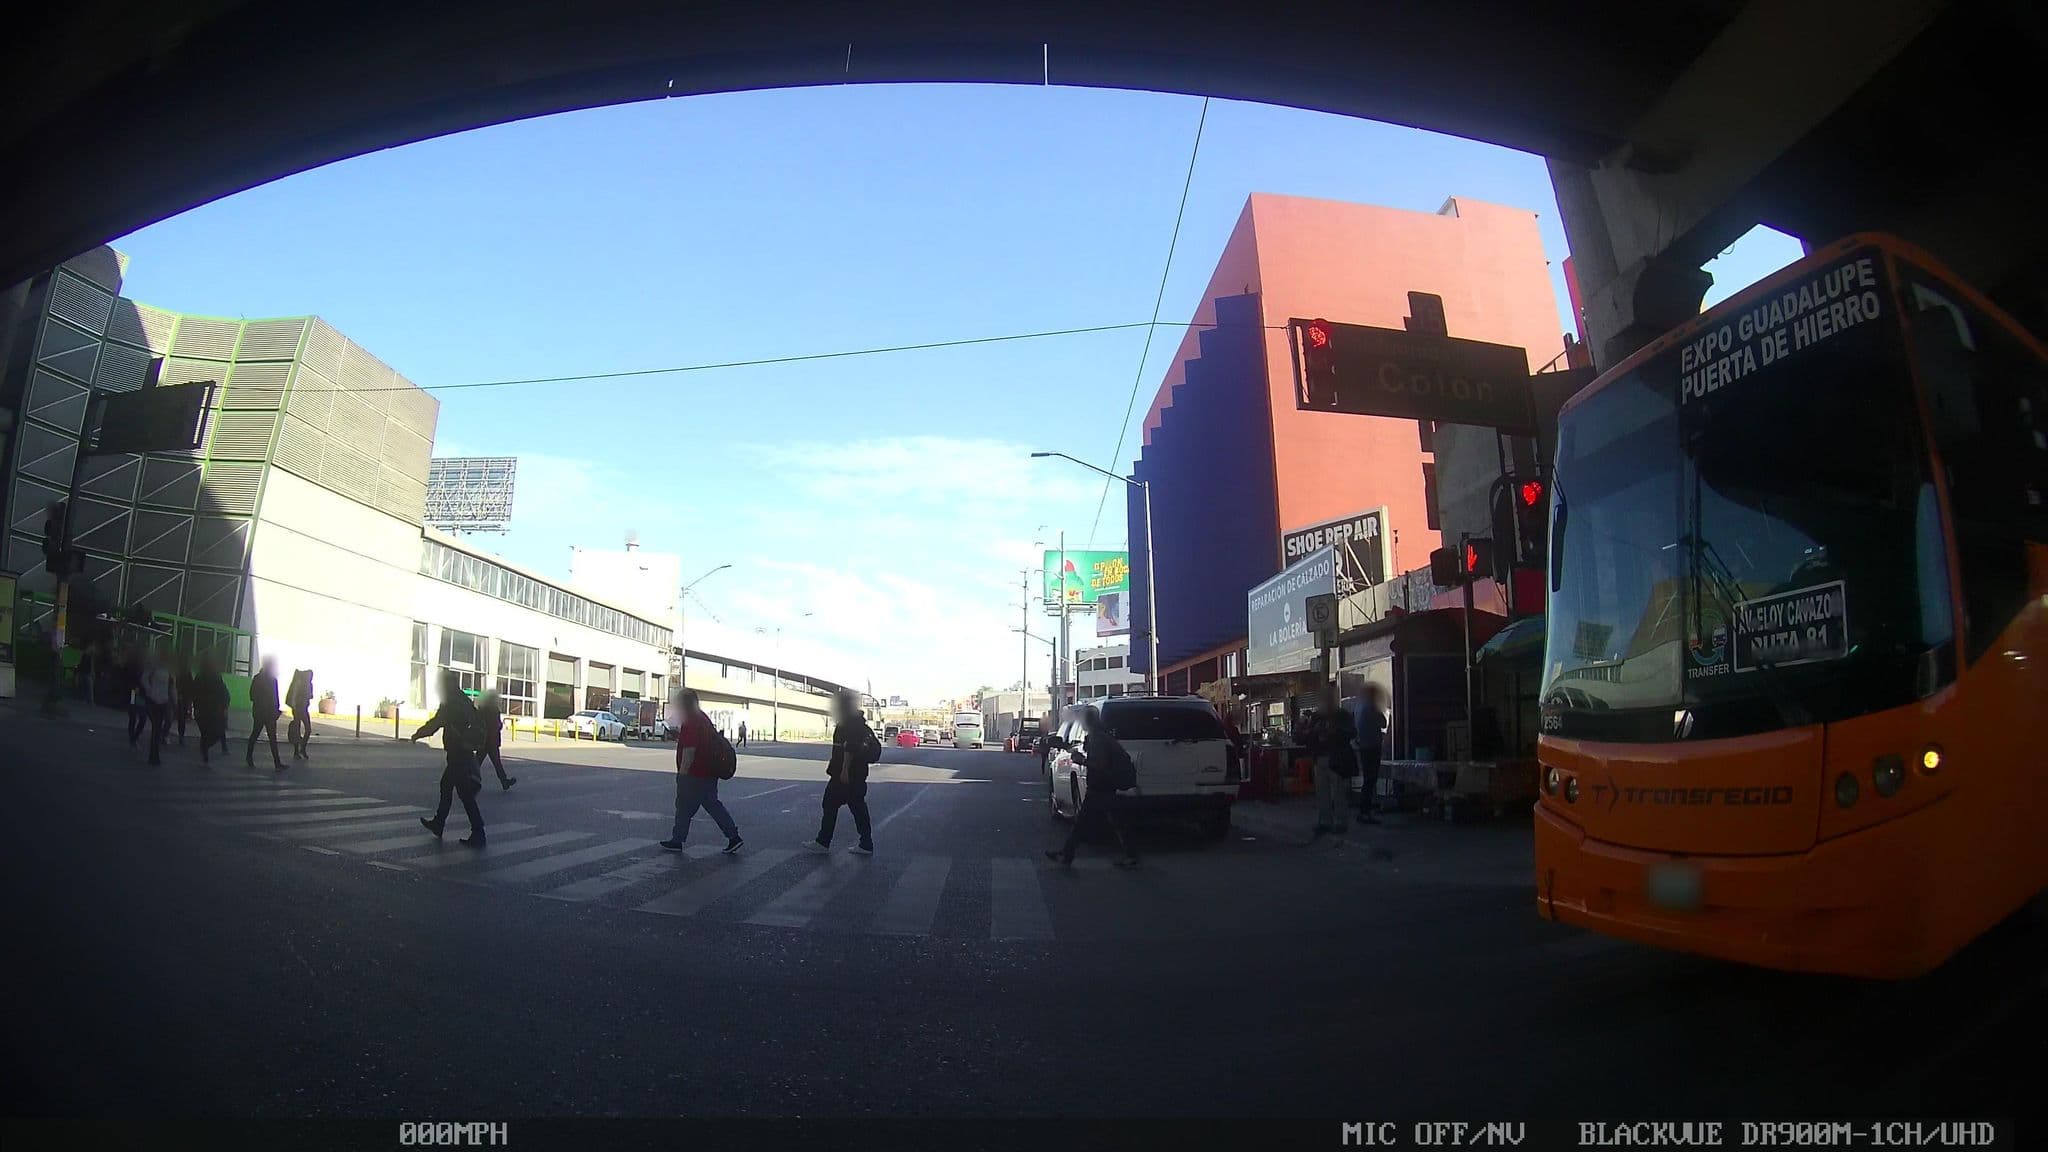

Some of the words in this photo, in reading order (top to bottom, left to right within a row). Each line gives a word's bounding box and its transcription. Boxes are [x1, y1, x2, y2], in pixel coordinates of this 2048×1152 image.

[1681, 326, 1732, 374] EXPO
[1738, 258, 1876, 342] GUADALUPE
[1681, 346, 1757, 405] PUERTA
[1760, 328, 1790, 367] DE
[1793, 291, 1881, 350] HIERRO
[1287, 530, 1324, 557] SHOE
[1325, 516, 1378, 546] REPAIR
[1286, 577, 1296, 593] DE
[1296, 559, 1330, 589] CALZADO
[1757, 602, 1785, 632] ELOY
[1787, 592, 1841, 625] CAVAZO
[1269, 629, 1278, 647] LA
[1687, 663, 1730, 679] TRANSFER
